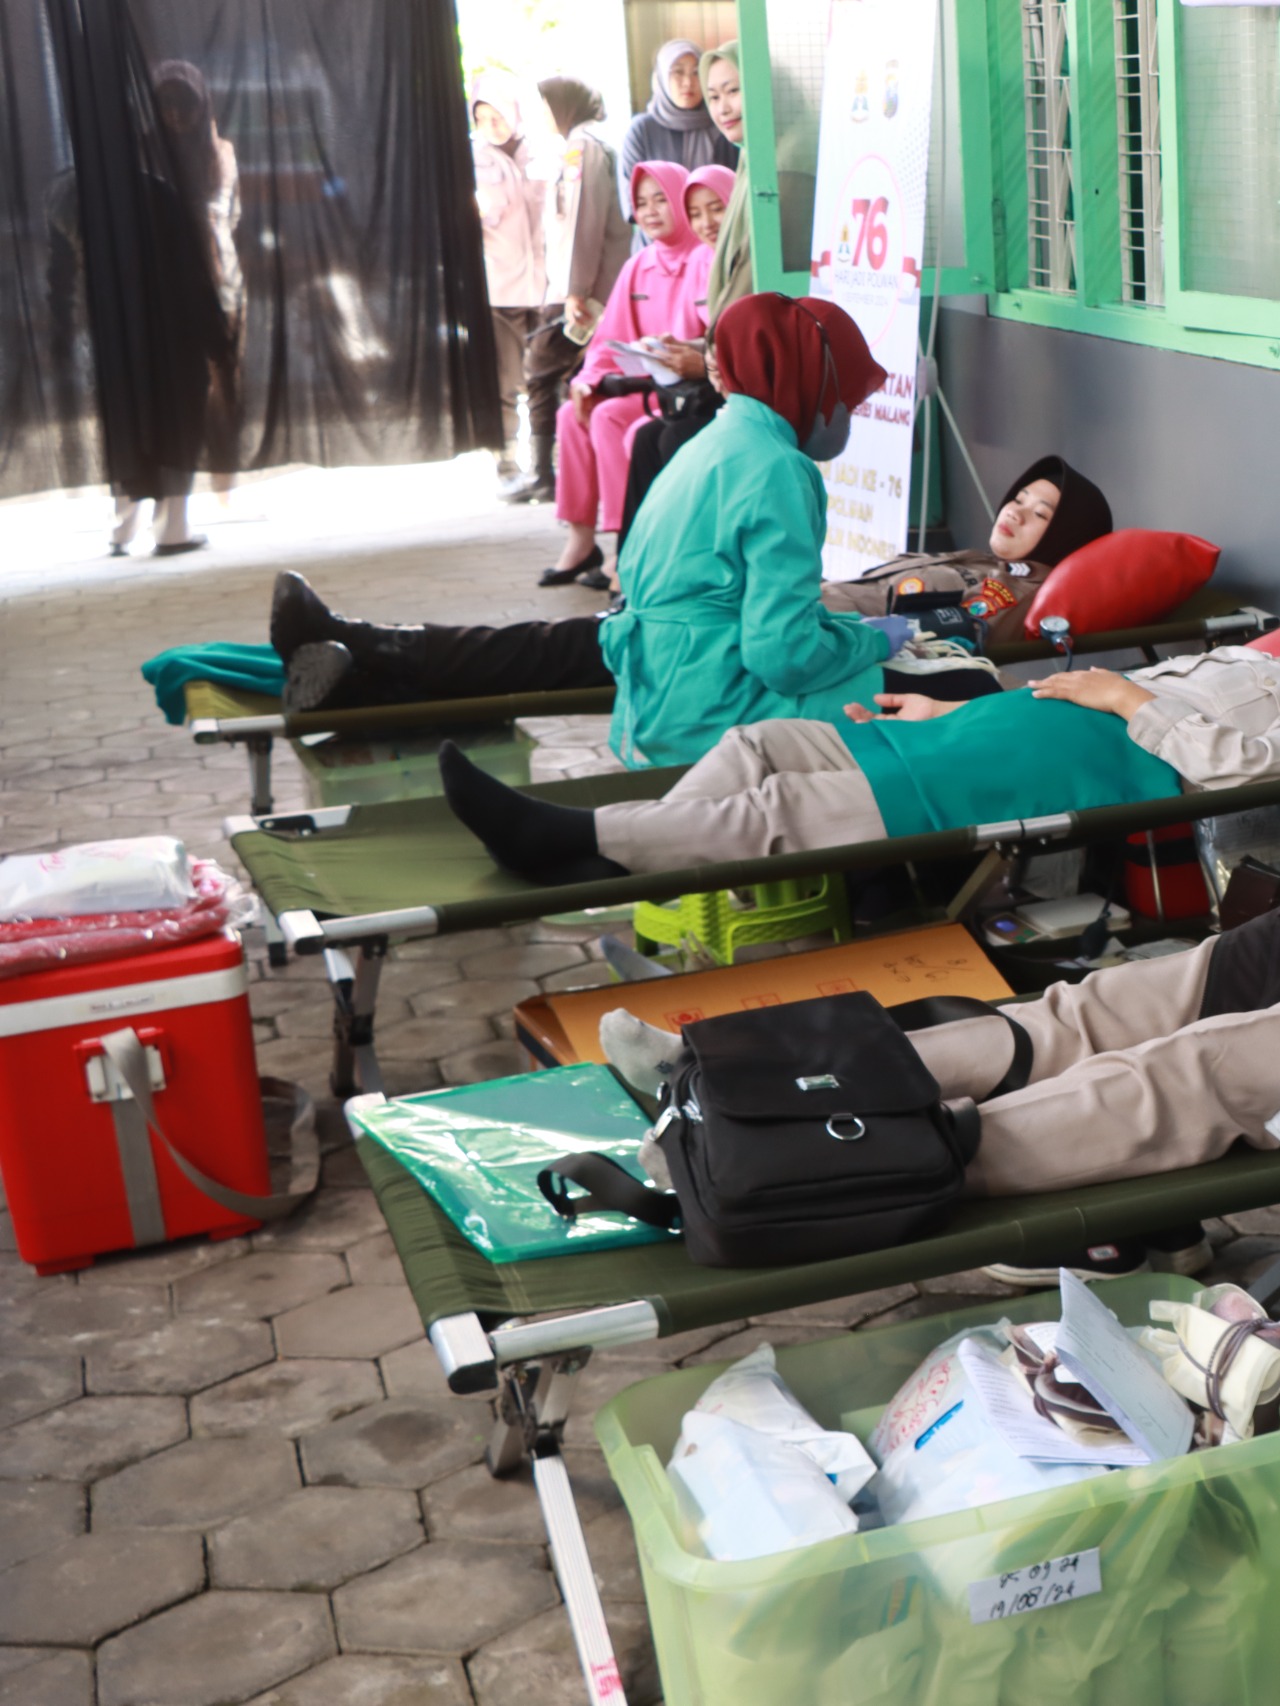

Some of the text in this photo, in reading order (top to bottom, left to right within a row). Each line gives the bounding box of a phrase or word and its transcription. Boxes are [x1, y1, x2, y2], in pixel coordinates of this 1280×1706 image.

[851, 196, 889, 271] 76
[875, 402, 910, 427] MALANG
[888, 474, 902, 499] 76
